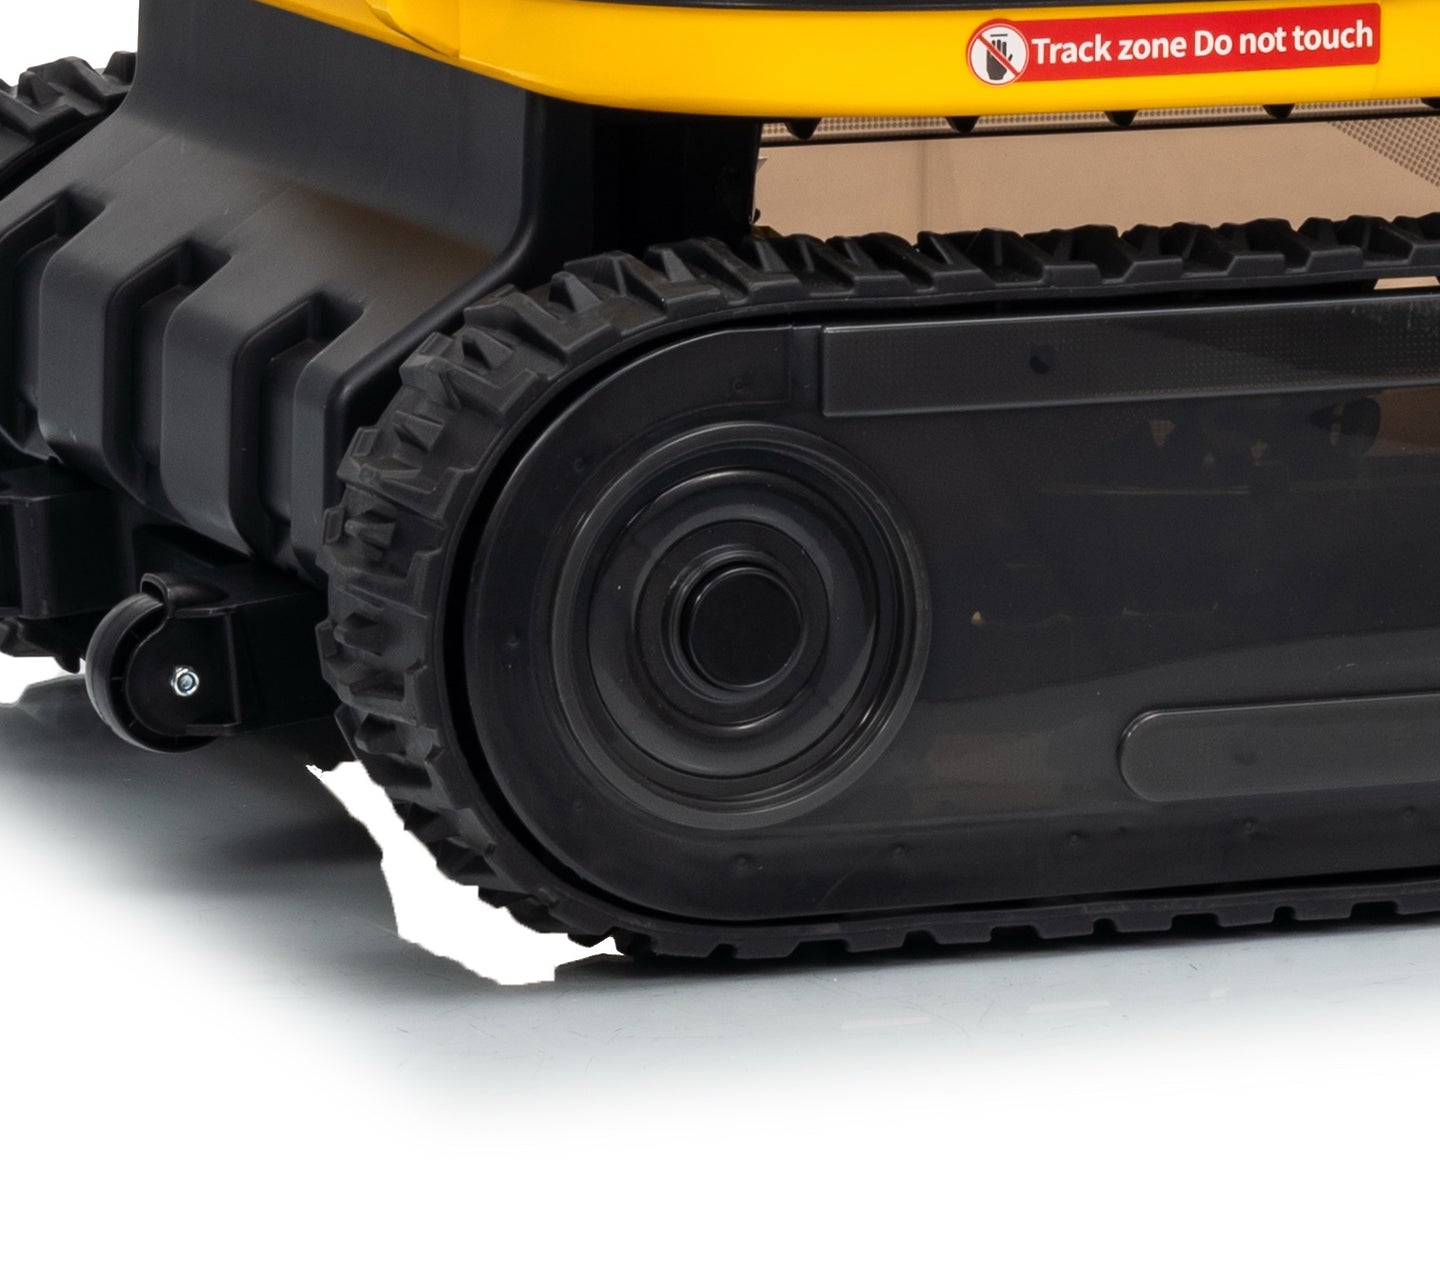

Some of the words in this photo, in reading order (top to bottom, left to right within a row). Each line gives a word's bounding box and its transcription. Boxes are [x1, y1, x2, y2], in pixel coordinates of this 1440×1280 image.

[1031, 34, 1113, 65] Track
[1118, 37, 1187, 61] zone
[1194, 30, 1233, 58] Do
[1239, 26, 1287, 54] not
[1293, 19, 1374, 52] touch
